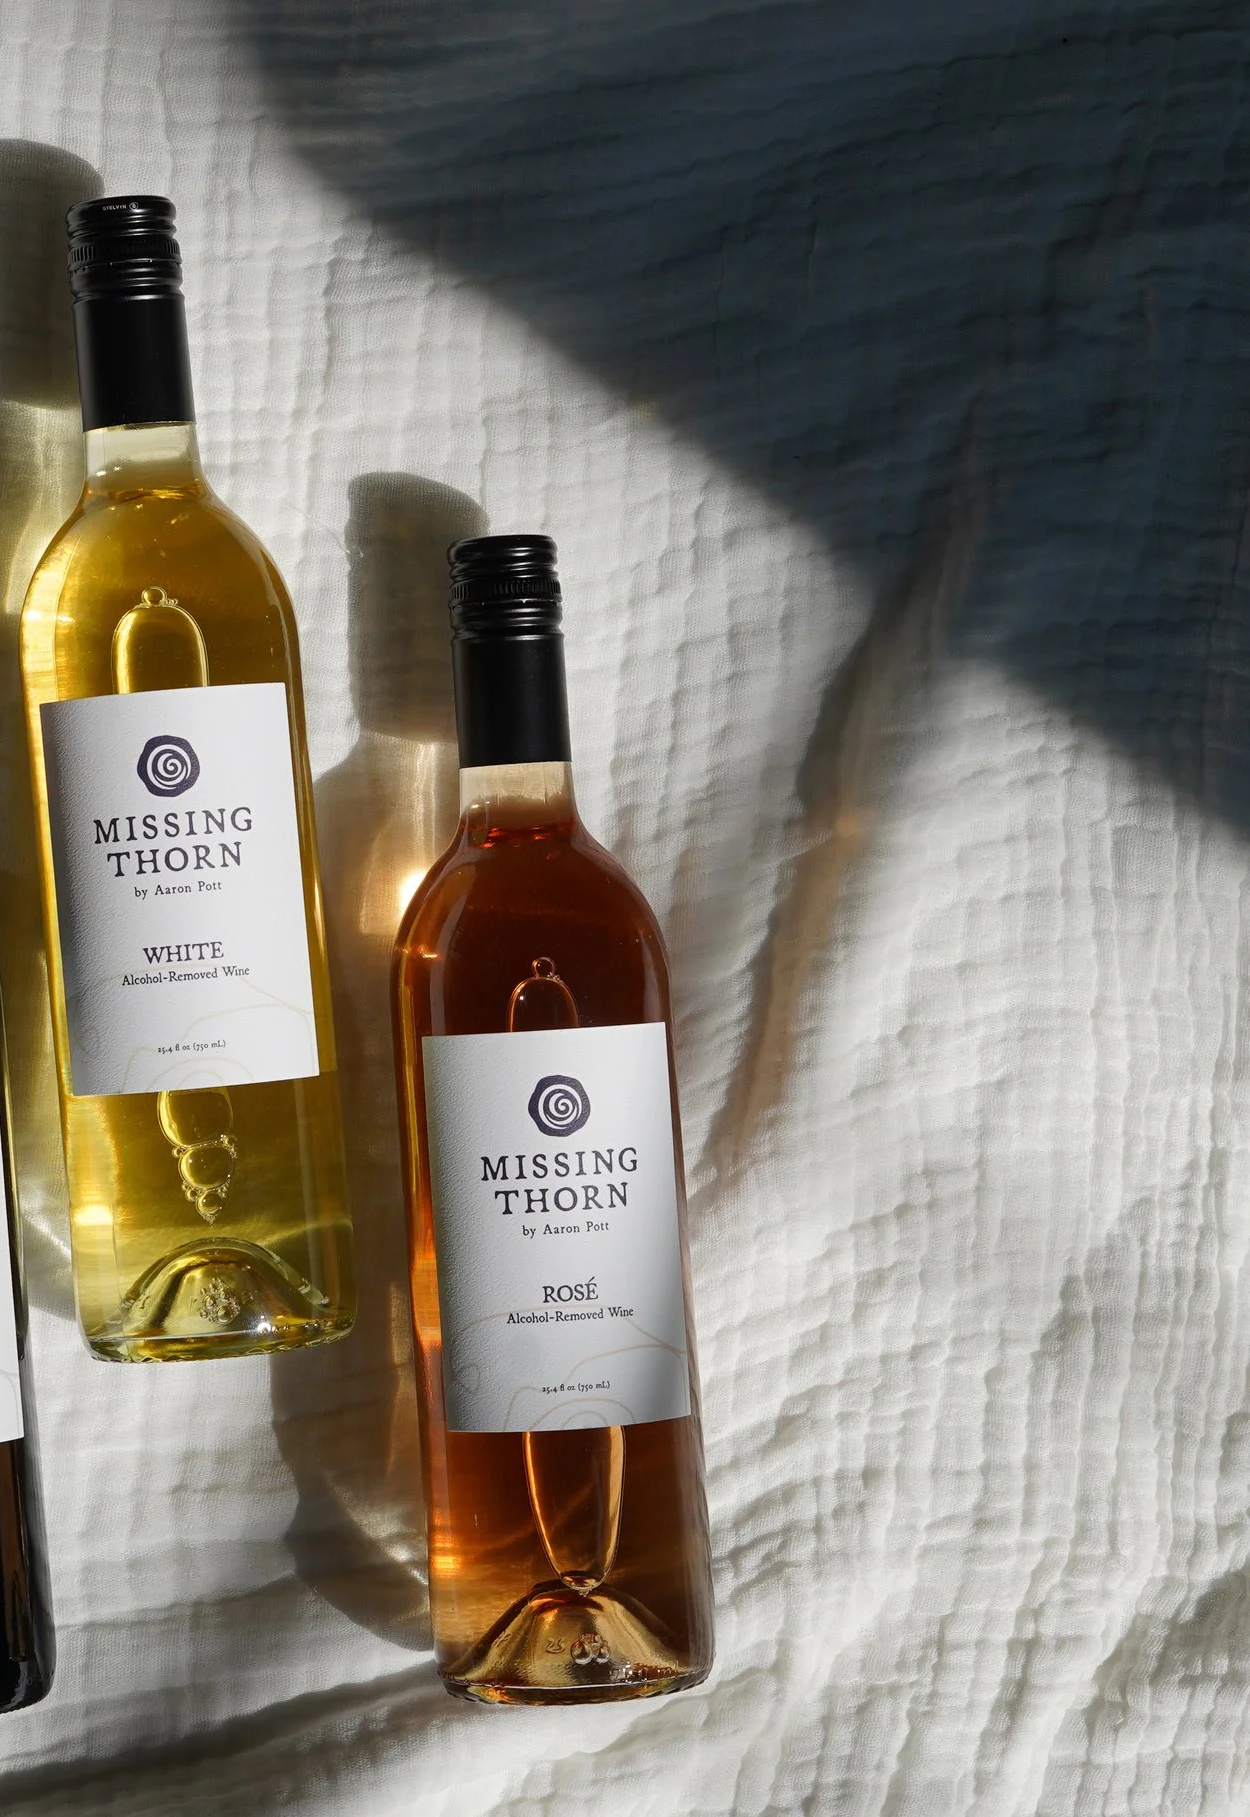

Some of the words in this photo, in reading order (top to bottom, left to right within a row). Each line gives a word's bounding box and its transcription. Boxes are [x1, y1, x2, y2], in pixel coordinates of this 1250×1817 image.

[93, 806, 253, 845] MISSING
[106, 841, 242, 878] THORN
[133, 886, 149, 901] by
[154, 884, 192, 896] Aaron
[197, 880, 222, 892] Pott
[142, 941, 225, 965] WHITE
[121, 967, 219, 987] Alcohol-Removed
[221, 965, 250, 977] Wine
[157, 1046, 174, 1055] 25.4
[192, 1042, 209, 1052] (750
[480, 1146, 638, 1182] MISSING
[494, 1181, 629, 1216] THORN
[522, 1224, 537, 1240] by
[542, 1223, 581, 1235] Aaron
[585, 1220, 609, 1233] Pott
[542, 1276, 599, 1304] ROSÉ
[506, 1307, 604, 1325] Alcohol-Removed
[607, 1306, 634, 1318] Wine
[542, 1386, 558, 1395] 25.4
[577, 1382, 594, 1393] (750
